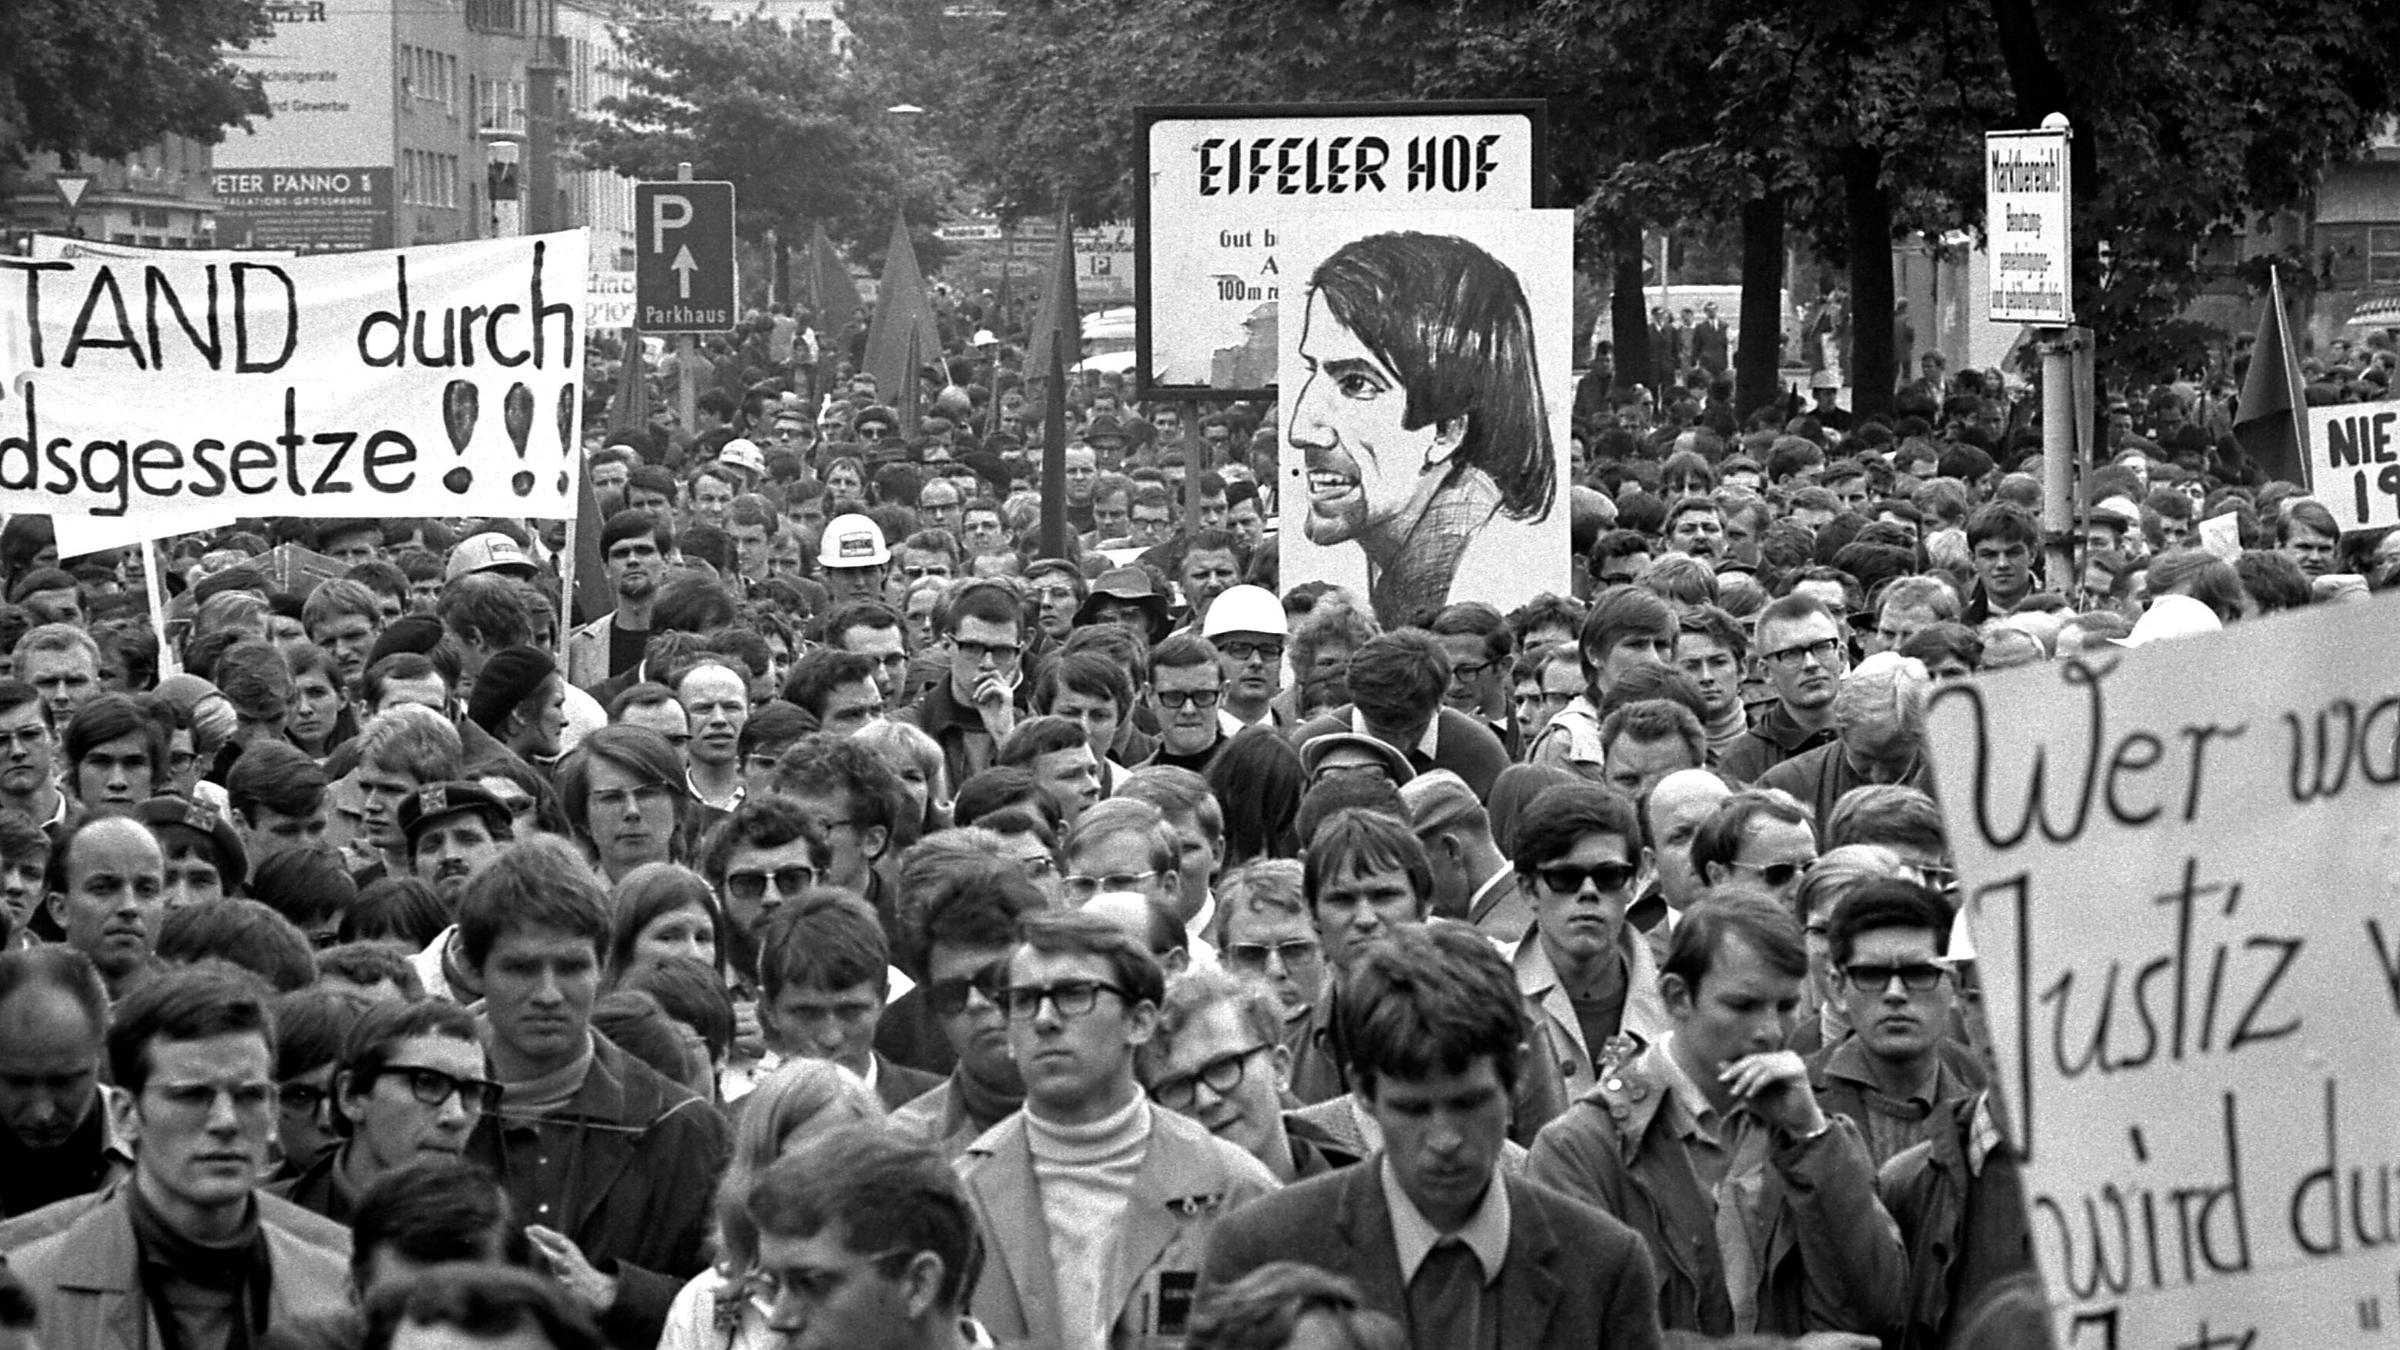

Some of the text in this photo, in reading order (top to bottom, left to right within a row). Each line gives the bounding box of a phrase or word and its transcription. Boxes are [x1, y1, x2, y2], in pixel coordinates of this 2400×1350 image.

[273, 174, 350, 193] PANNO
[1199, 134, 1502, 196] EIFELER HOF
[653, 194, 693, 254] P
[1264, 228, 1279, 248] b
[357, 241, 575, 370] durch
[645, 305, 727, 324] Parkhaus
[2327, 412, 2398, 469] NIE
[1927, 656, 2249, 850] Wer
[1974, 856, 2304, 1166] Justiz
[2034, 1092, 2251, 1300] wird
